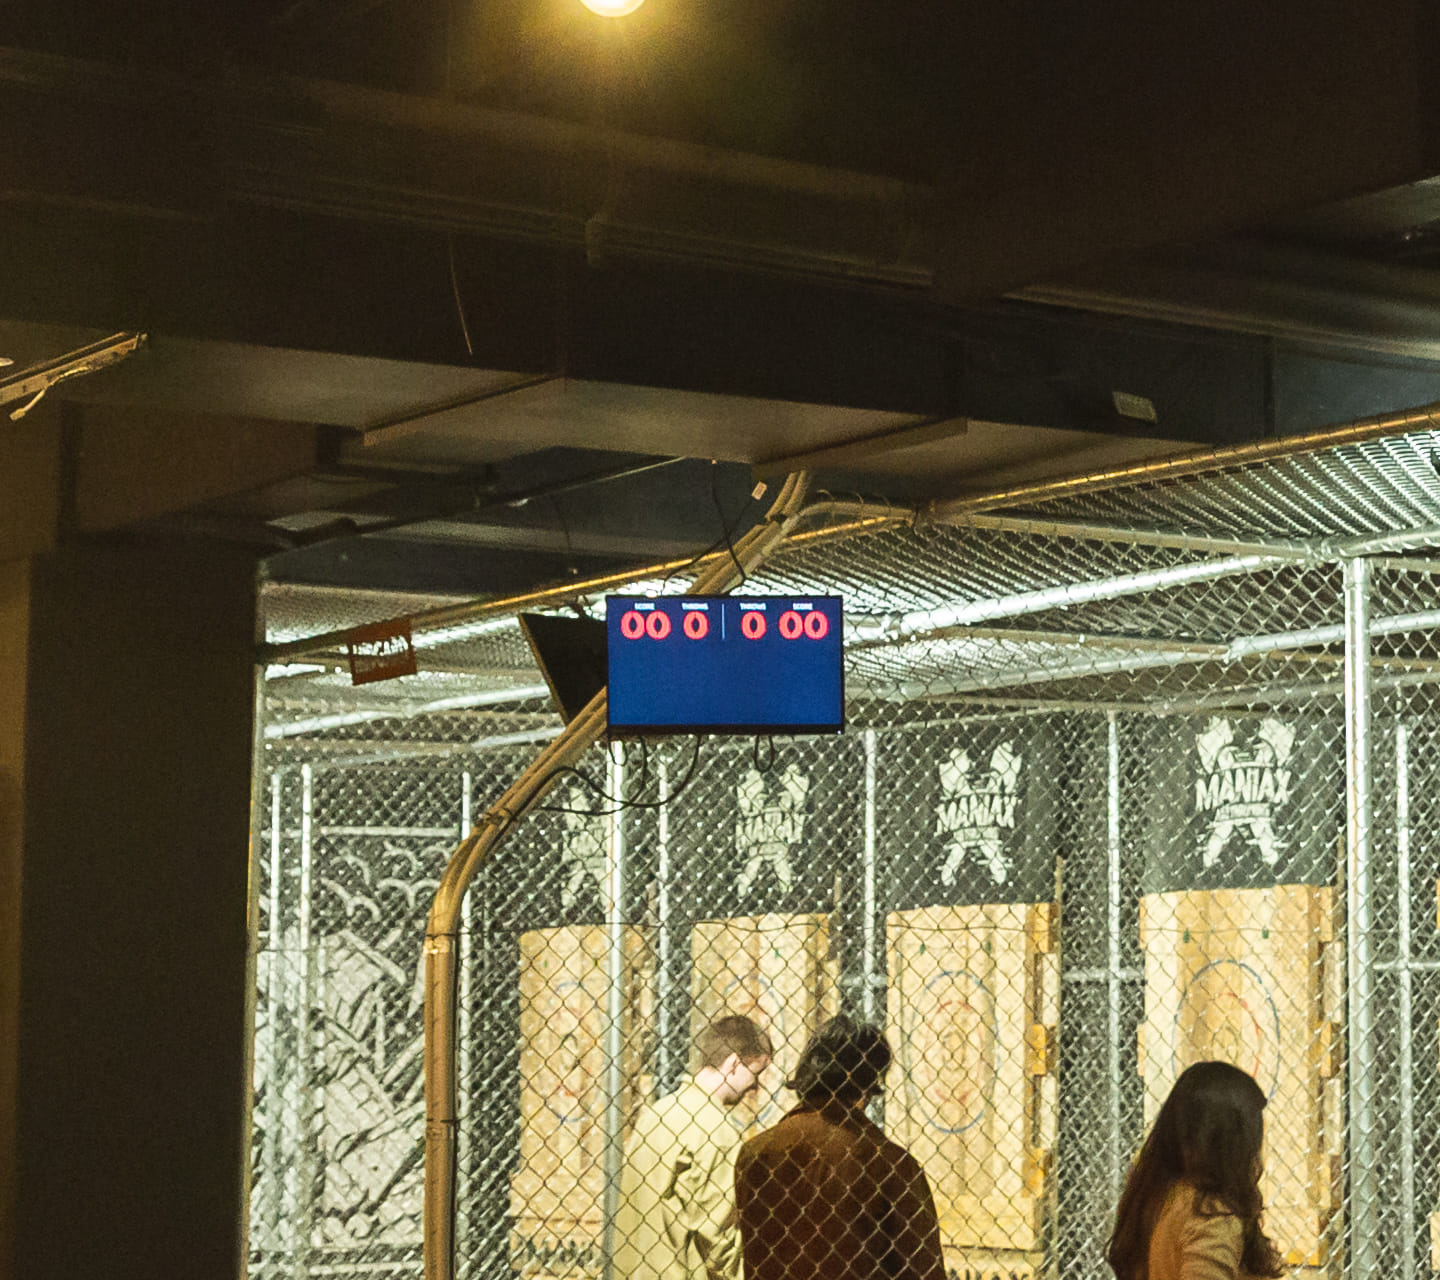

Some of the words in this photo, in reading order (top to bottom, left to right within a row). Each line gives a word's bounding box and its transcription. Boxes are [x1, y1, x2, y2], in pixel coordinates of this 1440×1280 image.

[682, 610, 709, 640] 0
[740, 610, 767, 640] 0
[1194, 767, 1292, 813] MANIAX
